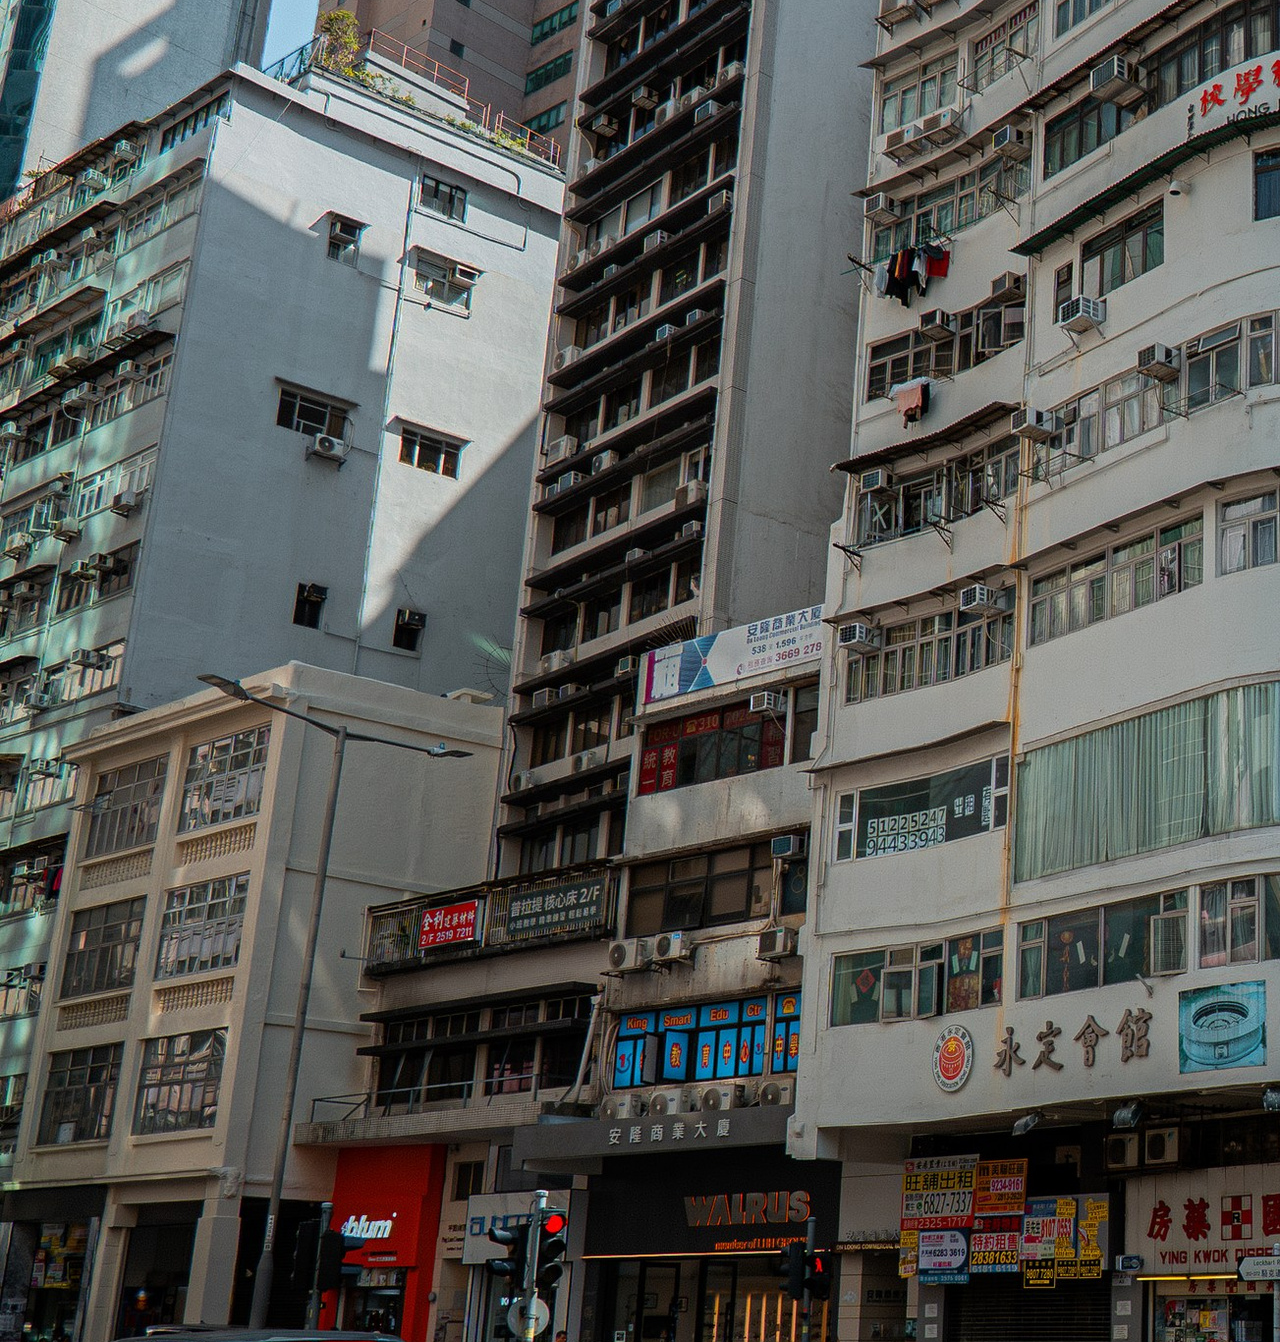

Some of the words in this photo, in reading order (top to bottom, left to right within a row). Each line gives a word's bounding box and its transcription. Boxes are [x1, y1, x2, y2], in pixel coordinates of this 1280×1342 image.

[1227, 103, 1270, 126] HONG
[747, 606, 822, 638] 安隆商業大廈
[752, 644, 767, 655] 538
[775, 648, 800, 662] 3669
[868, 806, 947, 836] 51225247
[867, 826, 946, 857] 94433943
[511, 896, 543, 918] 普拉提
[544, 890, 577, 911] 核心床
[580, 886, 601, 904] 2/F
[421, 933, 434, 945] 2/F
[436, 929, 454, 943] 2519
[456, 925, 473, 939] 7211
[627, 1017, 648, 1031] King
[664, 1012, 692, 1027] Smart
[710, 1008, 730, 1021] Edu
[746, 1004, 763, 1017] Ctr
[994, 1007, 1153, 1077] 永定會館
[608, 1118, 731, 1146] 安隆商業大廈
[905, 1171, 973, 1191] 旺舖出租
[991, 1178, 1023, 1193] 9234-9161
[684, 1190, 812, 1228] WALRUS
[923, 1191, 973, 1215] 6827-7337
[347, 1214, 393, 1239] blum
[918, 1216, 967, 1229] 2325-1717
[932, 1249, 947, 1258] 6283
[949, 1247, 966, 1257] 3619
[972, 1233, 1018, 1251] 特約租售
[971, 1251, 1018, 1265] 28381633
[1160, 1250, 1188, 1265] YING
[1194, 1249, 1229, 1264] KWOK
